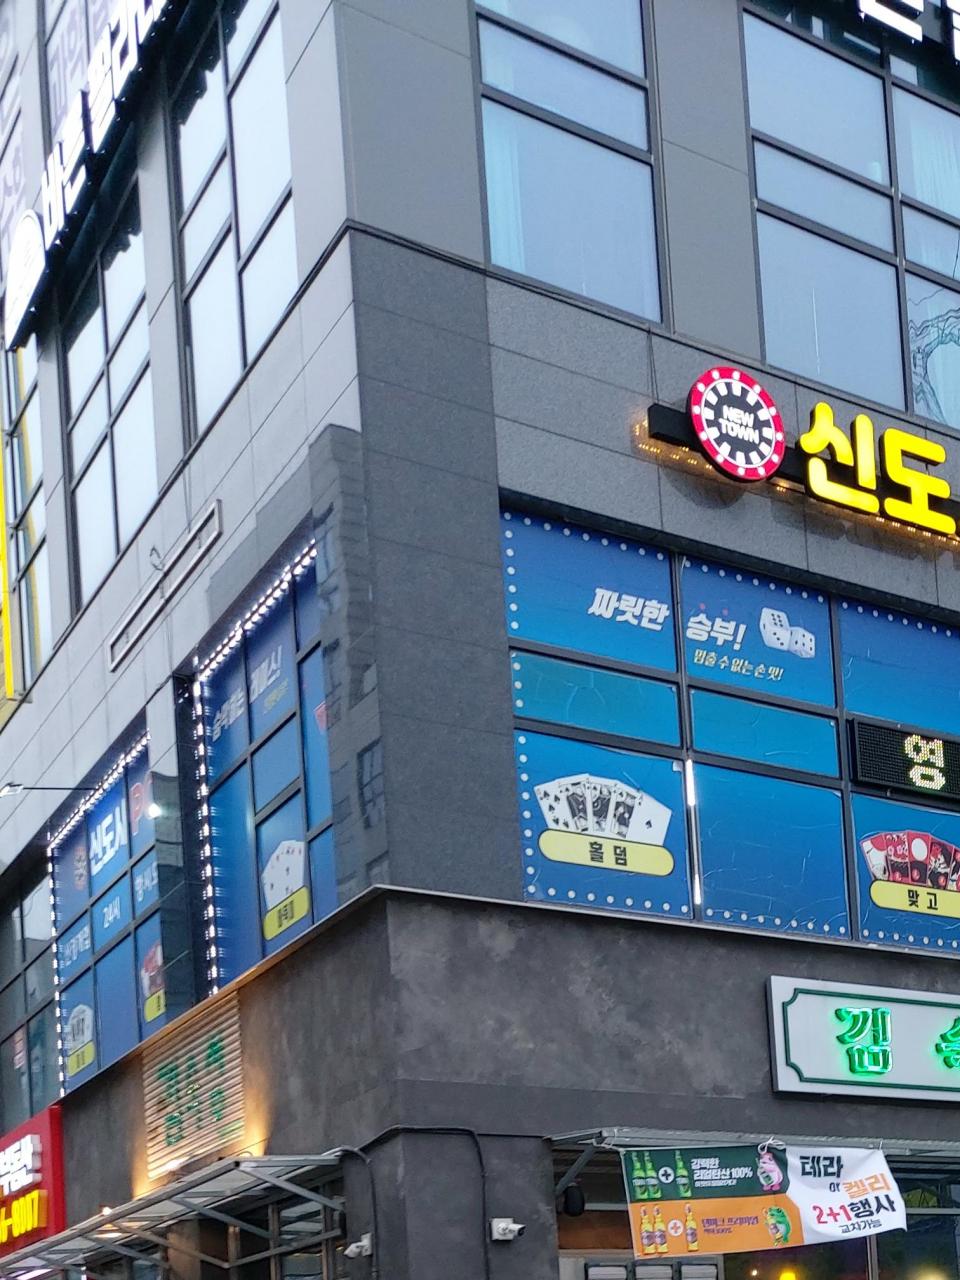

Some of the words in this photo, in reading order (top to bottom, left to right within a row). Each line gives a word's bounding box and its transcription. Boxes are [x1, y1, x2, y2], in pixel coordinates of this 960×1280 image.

[723, 404, 754, 428] NEW
[718, 417, 759, 445] TOWN
[587, 588, 669, 632] 짜릿한
[686, 611, 748, 651] 승부!
[731, 1167, 754, 1179] 100%
[800, 1154, 844, 1179] 테라
[829, 1181, 841, 1193] or
[842, 1173, 893, 1199] 켈리
[812, 1195, 897, 1225] 2+1행사
